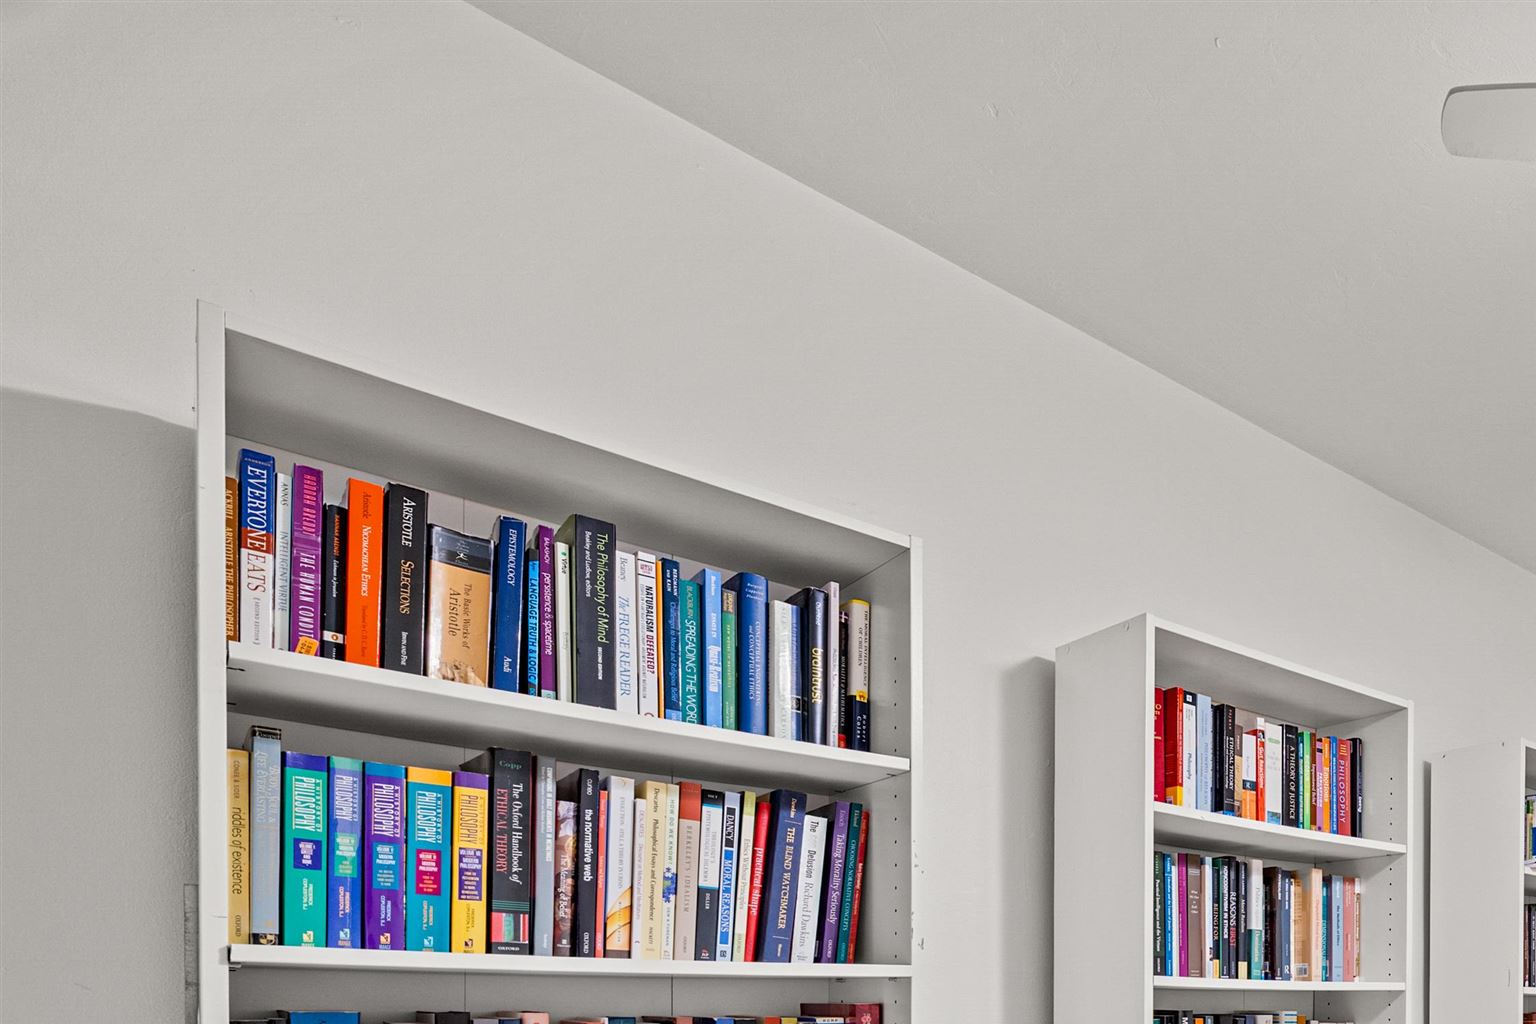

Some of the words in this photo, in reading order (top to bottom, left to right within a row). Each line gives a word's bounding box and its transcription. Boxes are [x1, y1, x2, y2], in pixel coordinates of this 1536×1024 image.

[303, 474, 316, 505] HANNAH
[247, 466, 266, 550] EVERYONE
[303, 508, 316, 536] ARENDT
[597, 533, 608, 551] The
[247, 553, 266, 592] EATS
[300, 553, 316, 568] THE
[507, 529, 517, 586] EPISTEMOLOGY
[300, 572, 315, 600] HUMAN
[463, 584, 471, 596] The
[595, 552, 608, 603] Philosophy
[448, 588, 460, 636] Aristotle
[463, 598, 471, 616] Basic
[529, 578, 539, 620] LANGUAGE
[597, 606, 608, 616] of
[618, 596, 629, 611] The
[462, 619, 471, 639] Works
[529, 622, 537, 647] TRUTH
[598, 618, 609, 642] Mind
[618, 612, 630, 649] FREGE
[462, 641, 470, 649] of
[646, 635, 655, 674] DEFEATED?
[685, 619, 696, 673] SPREADING
[503, 656, 512, 672] Audi
[528, 656, 537, 680] LOGIC
[619, 652, 631, 696] READER
[811, 648, 823, 704] braintrust
[686, 674, 696, 693] THE
[512, 783, 522, 798] The
[1289, 782, 1295, 790] OF
[294, 776, 318, 831] PHILOSOPHY
[374, 784, 393, 837] PHILOSOPHY
[417, 791, 436, 843] PHILOSOPHY
[497, 788, 507, 831] ETHICAL
[512, 801, 522, 829] Oxford
[232, 807, 245, 837] riddles
[725, 815, 734, 840] DANCY
[786, 827, 795, 843] THE
[230, 840, 246, 851] of
[496, 834, 507, 874] THEORY
[511, 831, 522, 872] Handbook
[584, 822, 593, 863] normative
[784, 846, 793, 869] BLIND
[834, 834, 844, 858] Taking
[232, 851, 244, 894] existence
[509, 874, 522, 885] of
[584, 864, 592, 881] web
[722, 860, 731, 890] MORAL
[830, 859, 841, 889] Morality
[721, 893, 730, 932] REASONS
[777, 873, 790, 929] WATCHMAKER
[828, 890, 840, 924] Seriously
